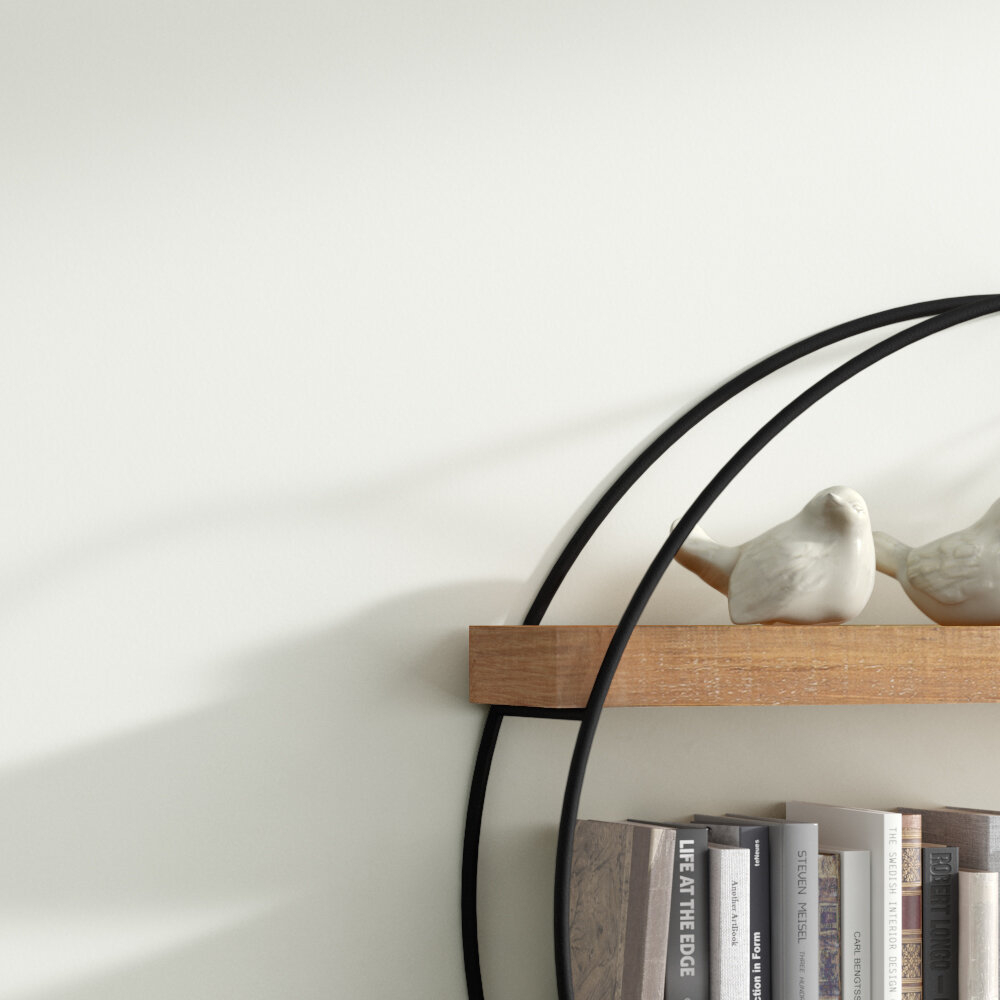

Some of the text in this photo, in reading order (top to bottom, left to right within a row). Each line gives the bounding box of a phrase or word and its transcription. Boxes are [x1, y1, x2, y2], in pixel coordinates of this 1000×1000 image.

[889, 827, 897, 845] THE
[889, 852, 897, 895] SWEDISH
[679, 839, 695, 977] LIFE AT THE EDGE
[731, 880, 740, 947] Another ArtBook
[797, 850, 807, 944] STEVEN MEISEL
[752, 932, 761, 959] Form
[889, 901, 897, 950] INTERIOR
[929, 919, 951, 970] LONGO
[752, 962, 761, 973] in
[889, 956, 897, 993] DESIGN
